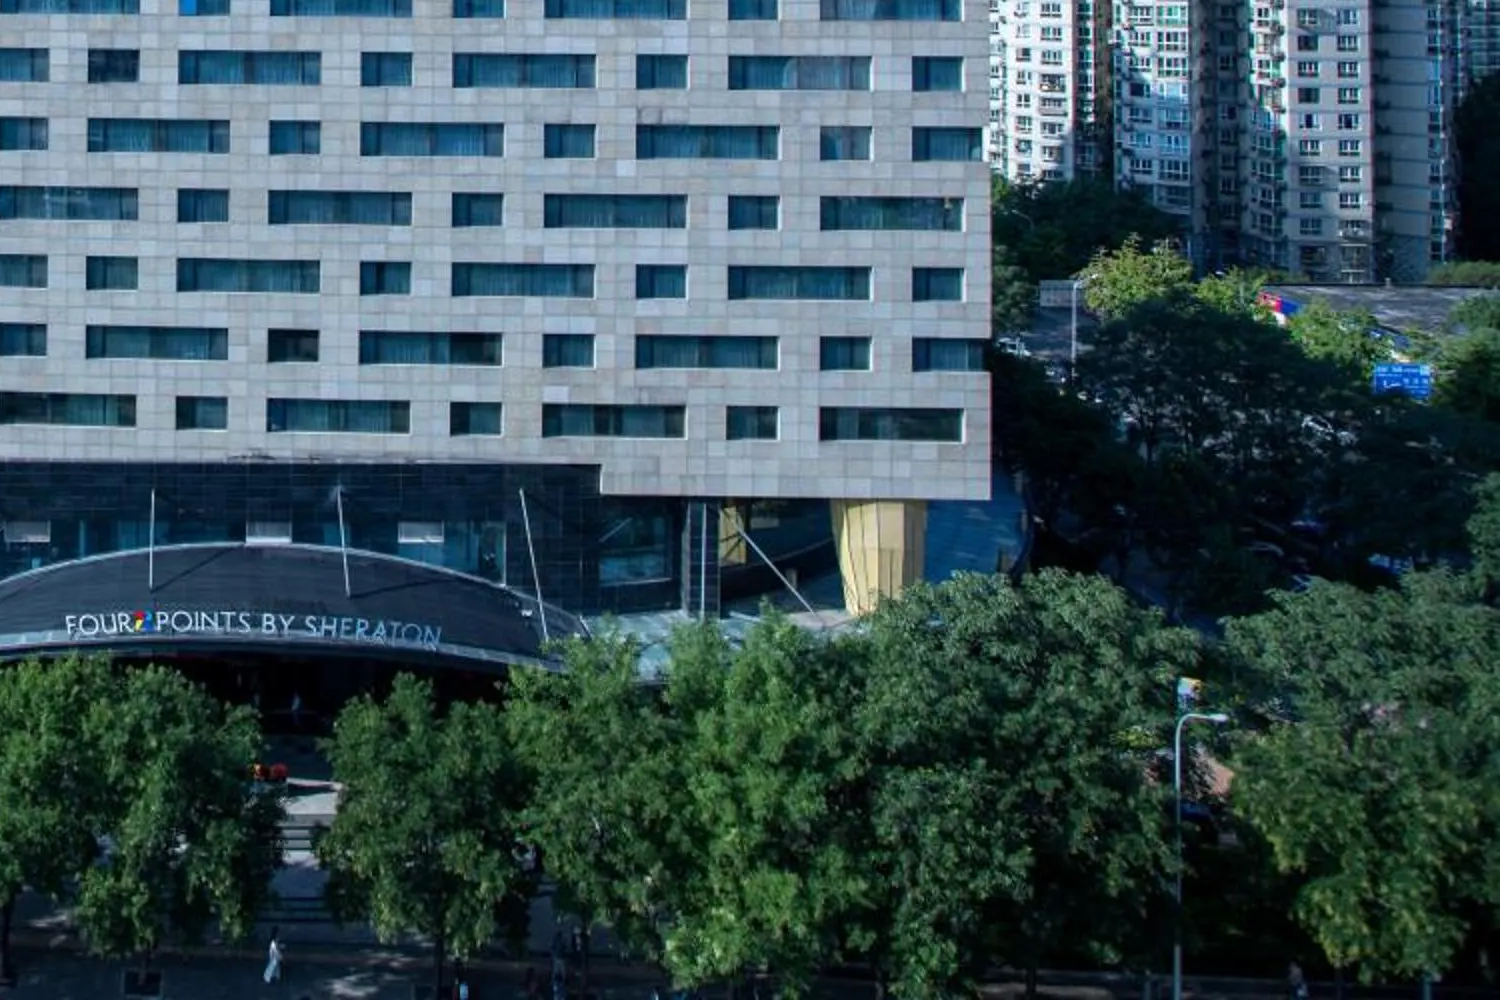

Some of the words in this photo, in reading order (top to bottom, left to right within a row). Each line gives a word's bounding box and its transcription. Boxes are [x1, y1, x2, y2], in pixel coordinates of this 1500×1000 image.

[65, 612, 135, 635] FOUR
[156, 610, 251, 634] POINTS
[262, 613, 295, 634] BY
[305, 615, 442, 647] SHERATON
